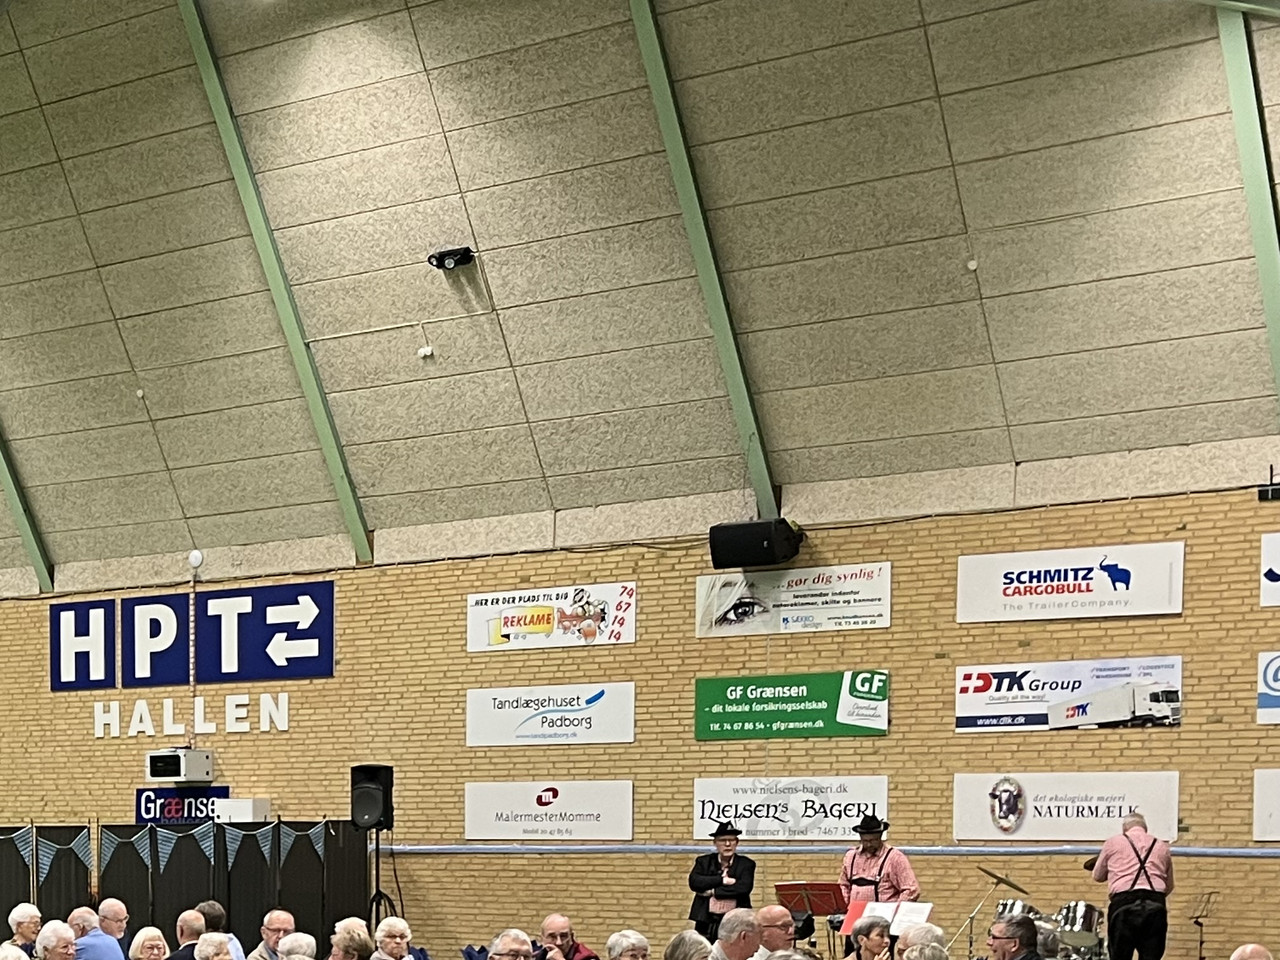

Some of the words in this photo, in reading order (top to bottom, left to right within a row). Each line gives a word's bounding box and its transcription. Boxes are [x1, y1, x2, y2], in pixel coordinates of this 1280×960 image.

[812, 573, 832, 586] dig
[837, 568, 874, 582] synlig
[1002, 567, 1095, 585] SCHMITZ
[619, 586, 635, 599] 74
[1001, 582, 1095, 598] CARGOBULL
[490, 597, 501, 606] ER
[502, 596, 517, 605] DER
[518, 594, 540, 604] PLADS
[542, 593, 553, 602] TIL
[615, 602, 632, 614] 67
[1002, 602, 1024, 611] The
[503, 613, 553, 629] REKLAME
[611, 615, 626, 628] 14
[607, 629, 622, 642] 14
[855, 672, 887, 694] GF
[1028, 679, 1082, 692] Group
[726, 685, 744, 700] GF
[746, 684, 808, 699] Grænsen
[491, 695, 581, 711] Tandlægehuset
[711, 703, 724, 713] dit
[725, 702, 750, 712] lokale
[751, 700, 828, 714] forsikringsselskab
[93, 691, 290, 739] HALLEN
[541, 716, 593, 730] Padborg
[722, 722, 732, 731] 74
[732, 784, 849, 797] www.nielsens-bageri.dk
[1032, 793, 1047, 803] det
[494, 811, 602, 823] MalermesterMomme
